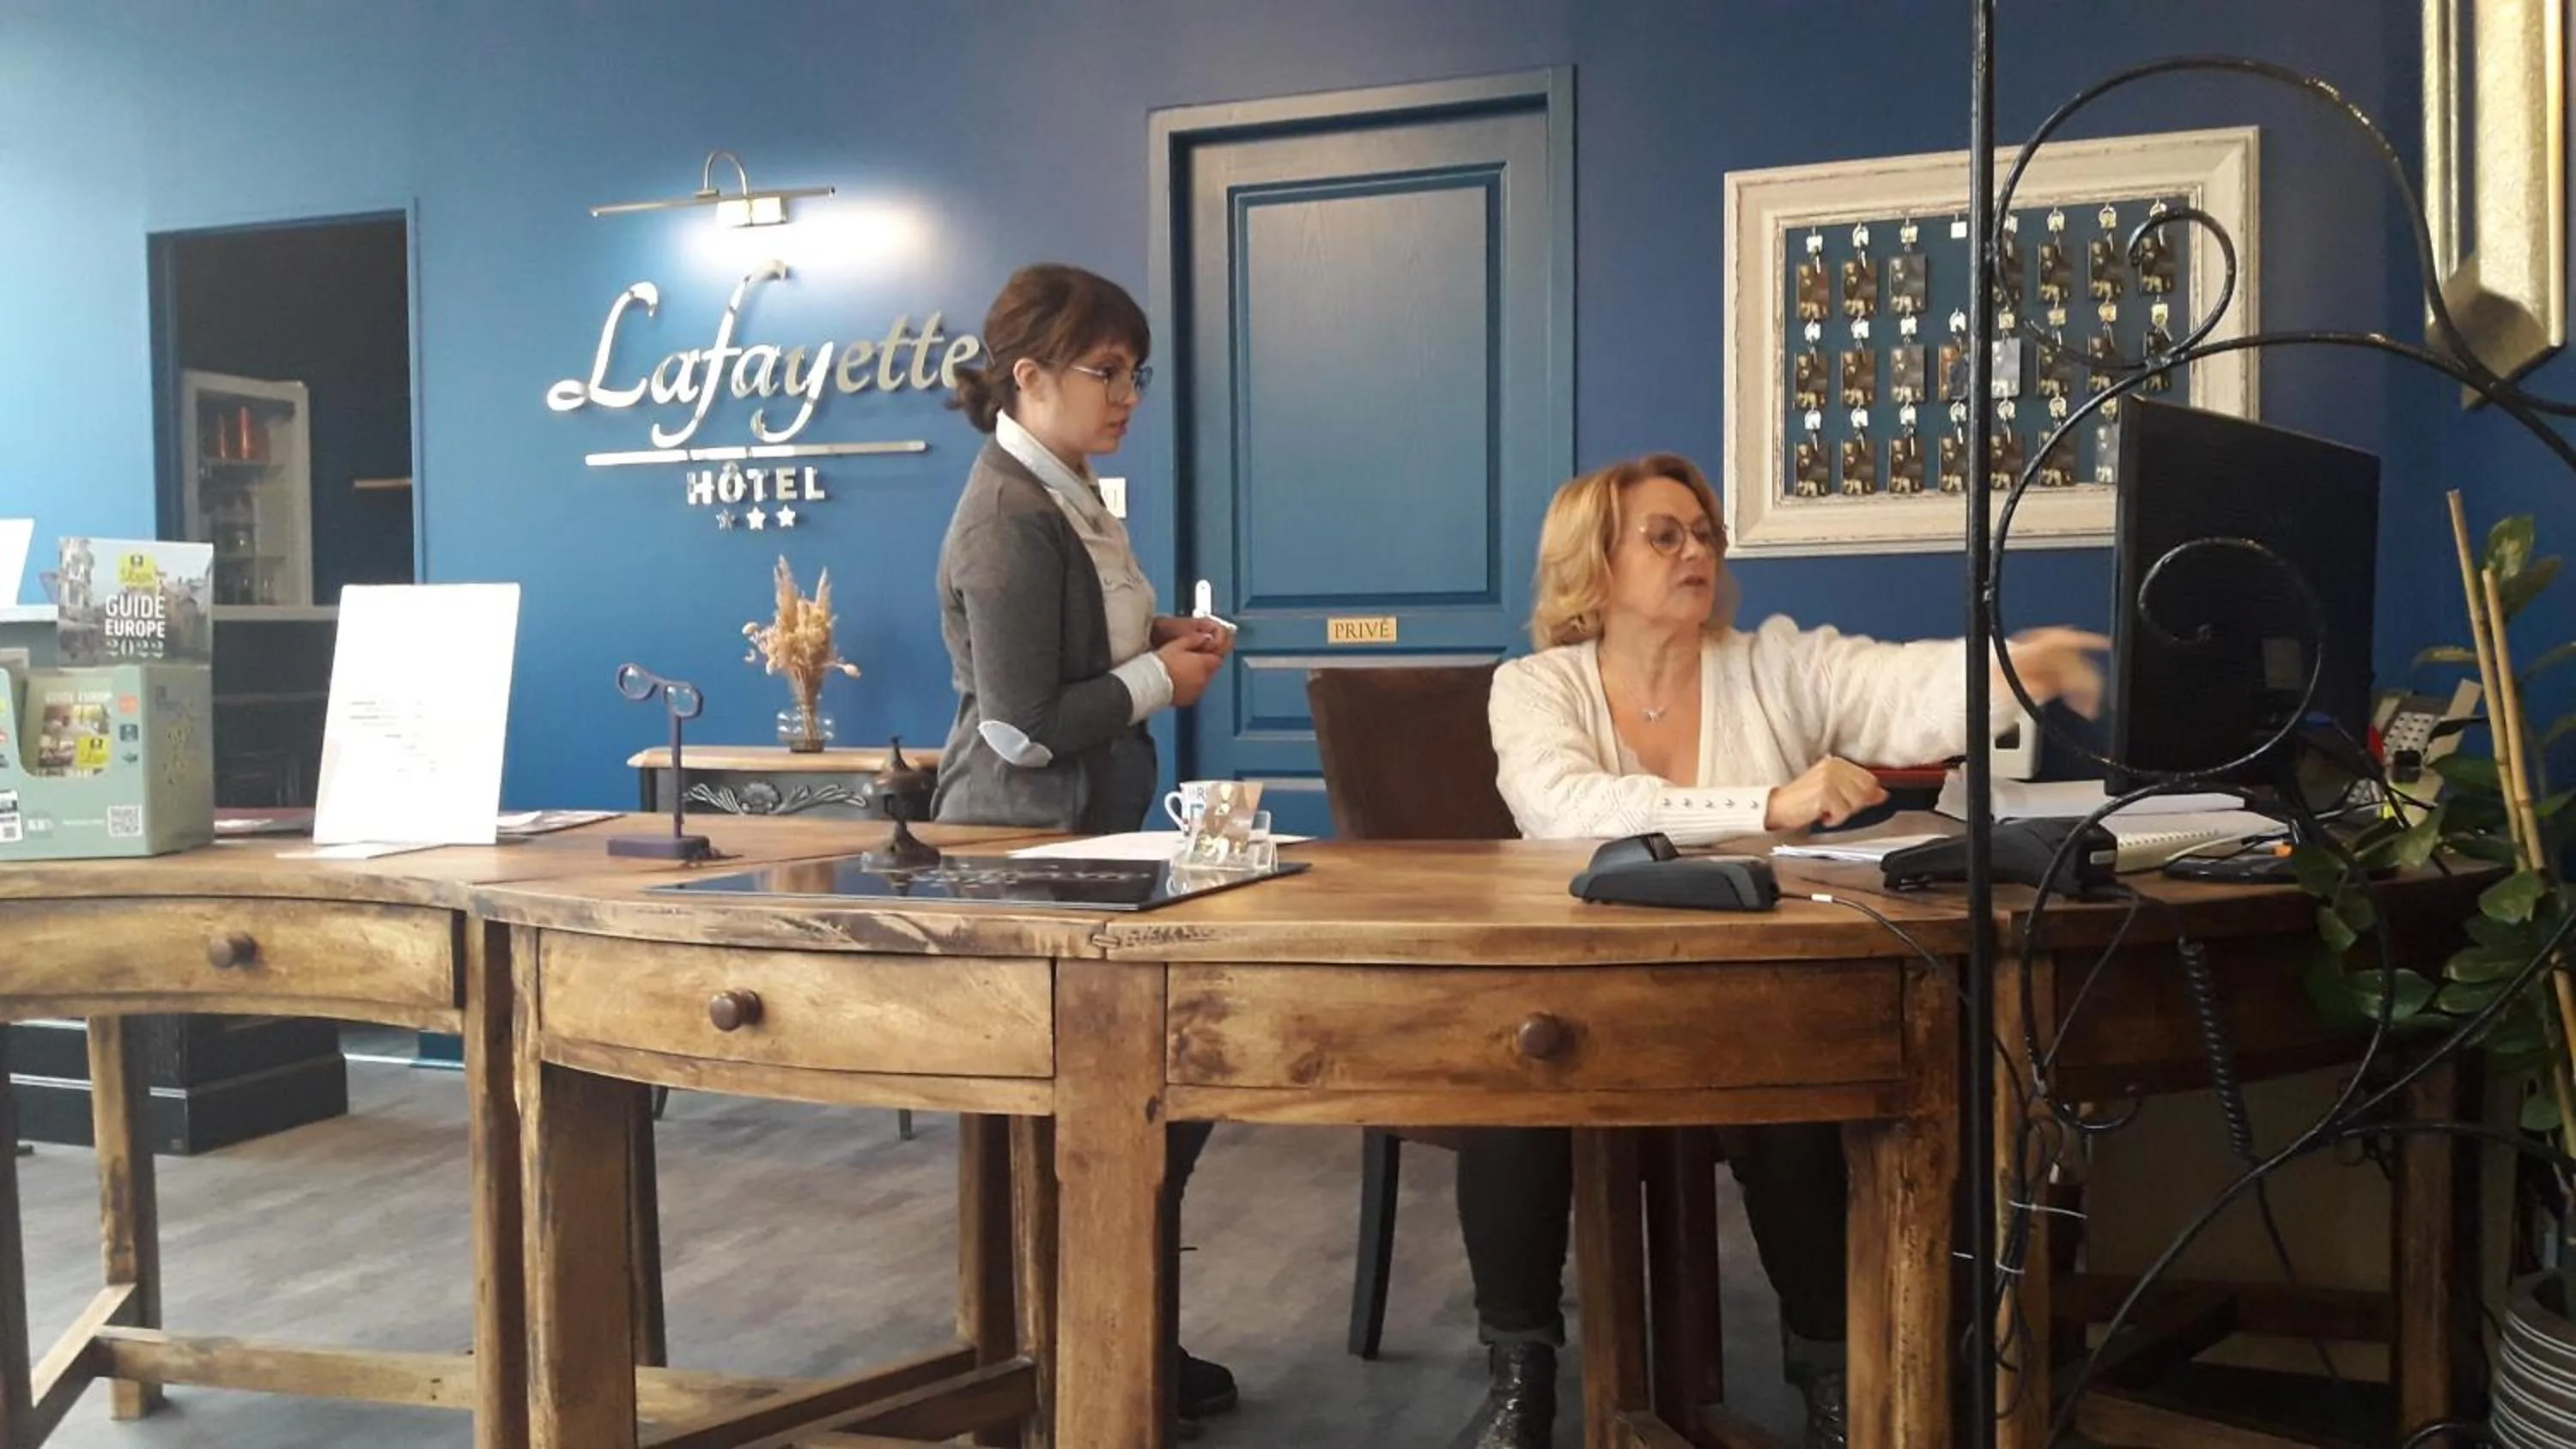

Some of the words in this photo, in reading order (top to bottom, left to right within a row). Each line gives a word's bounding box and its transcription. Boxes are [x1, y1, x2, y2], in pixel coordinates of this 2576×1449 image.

[547, 258, 980, 448] Lafayette
[687, 460, 825, 505] HÔTEL
[105, 593, 166, 619] GUIDE
[104, 618, 166, 639] EUROPE
[1334, 618, 1389, 640] PRIVÉ
